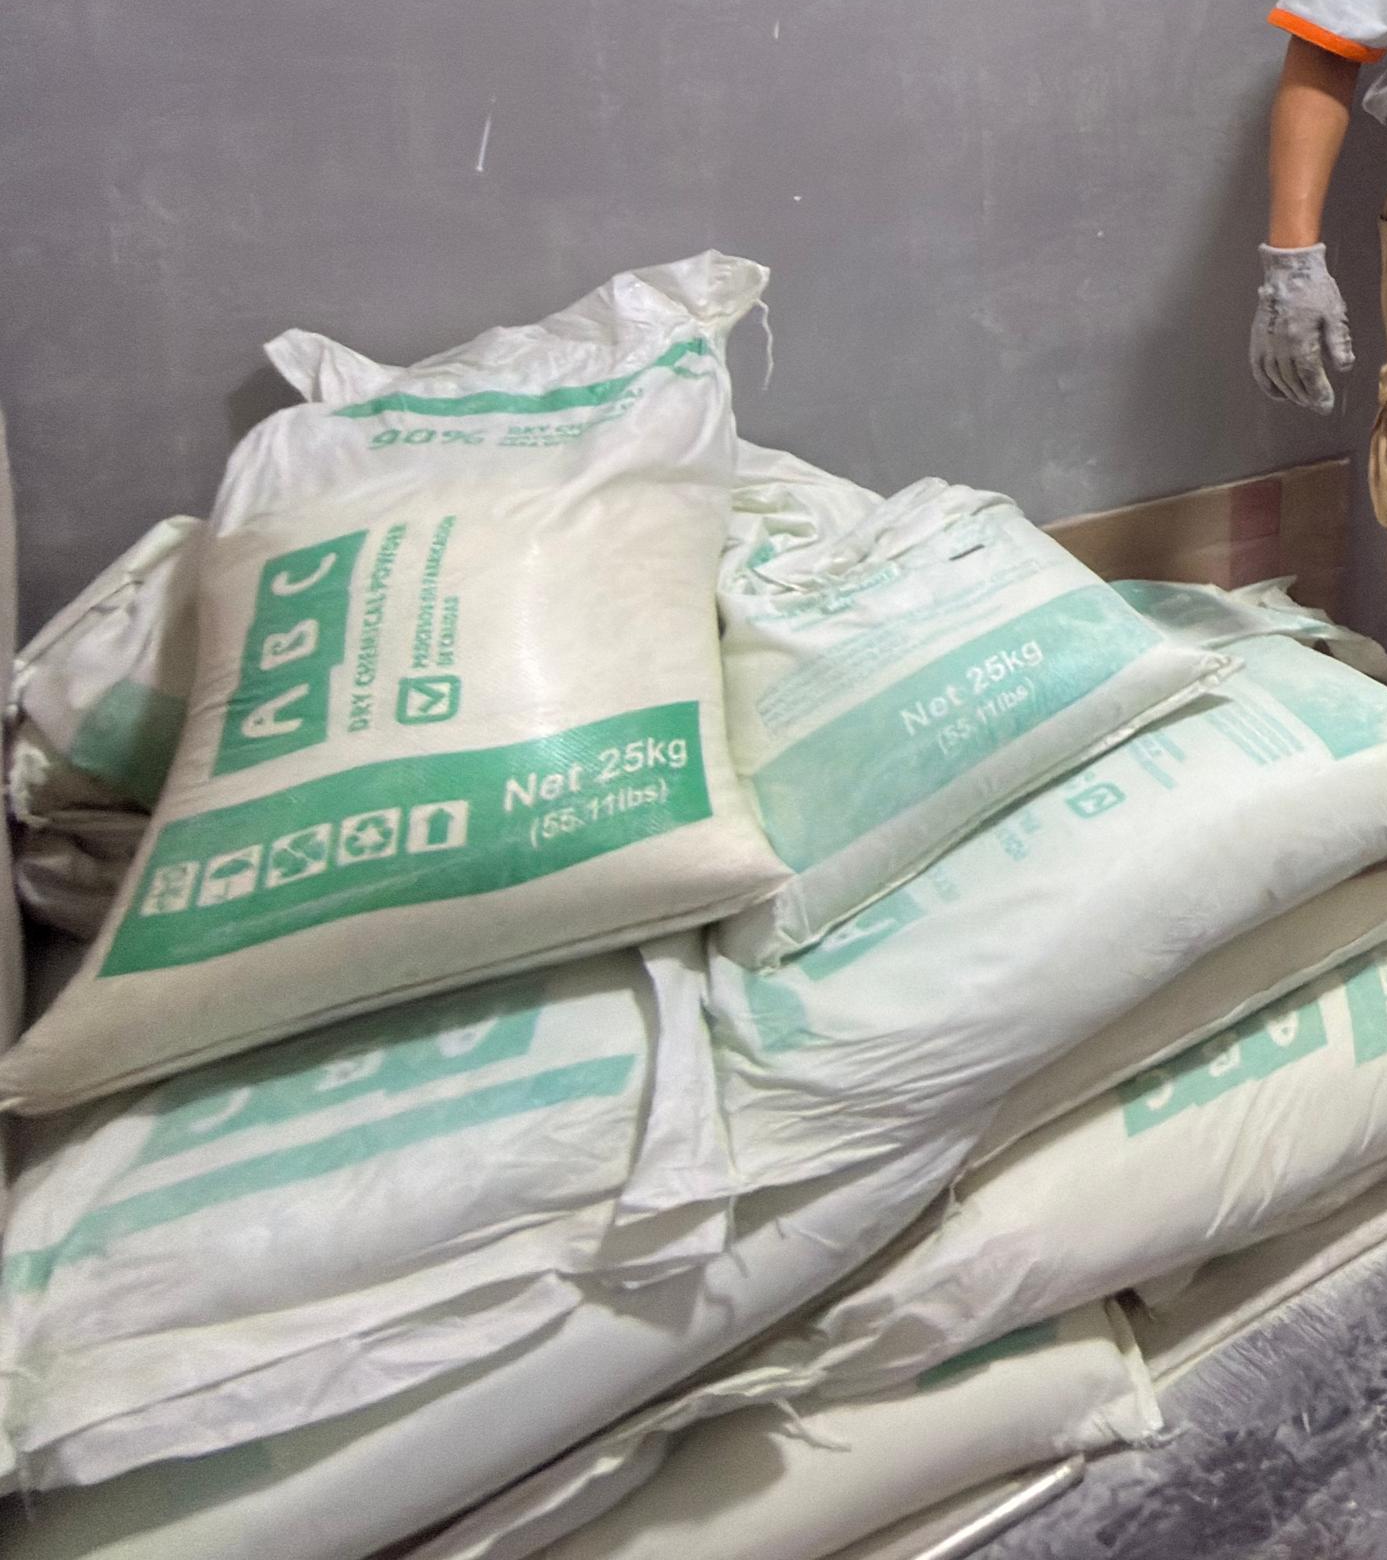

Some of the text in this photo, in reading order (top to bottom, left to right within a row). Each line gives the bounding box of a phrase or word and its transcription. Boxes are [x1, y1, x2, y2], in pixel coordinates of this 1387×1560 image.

[347, 692, 373, 733] DRY
[900, 682, 964, 737] Net
[964, 639, 1044, 696] 25kg
[503, 735, 689, 814] Net 25kg
